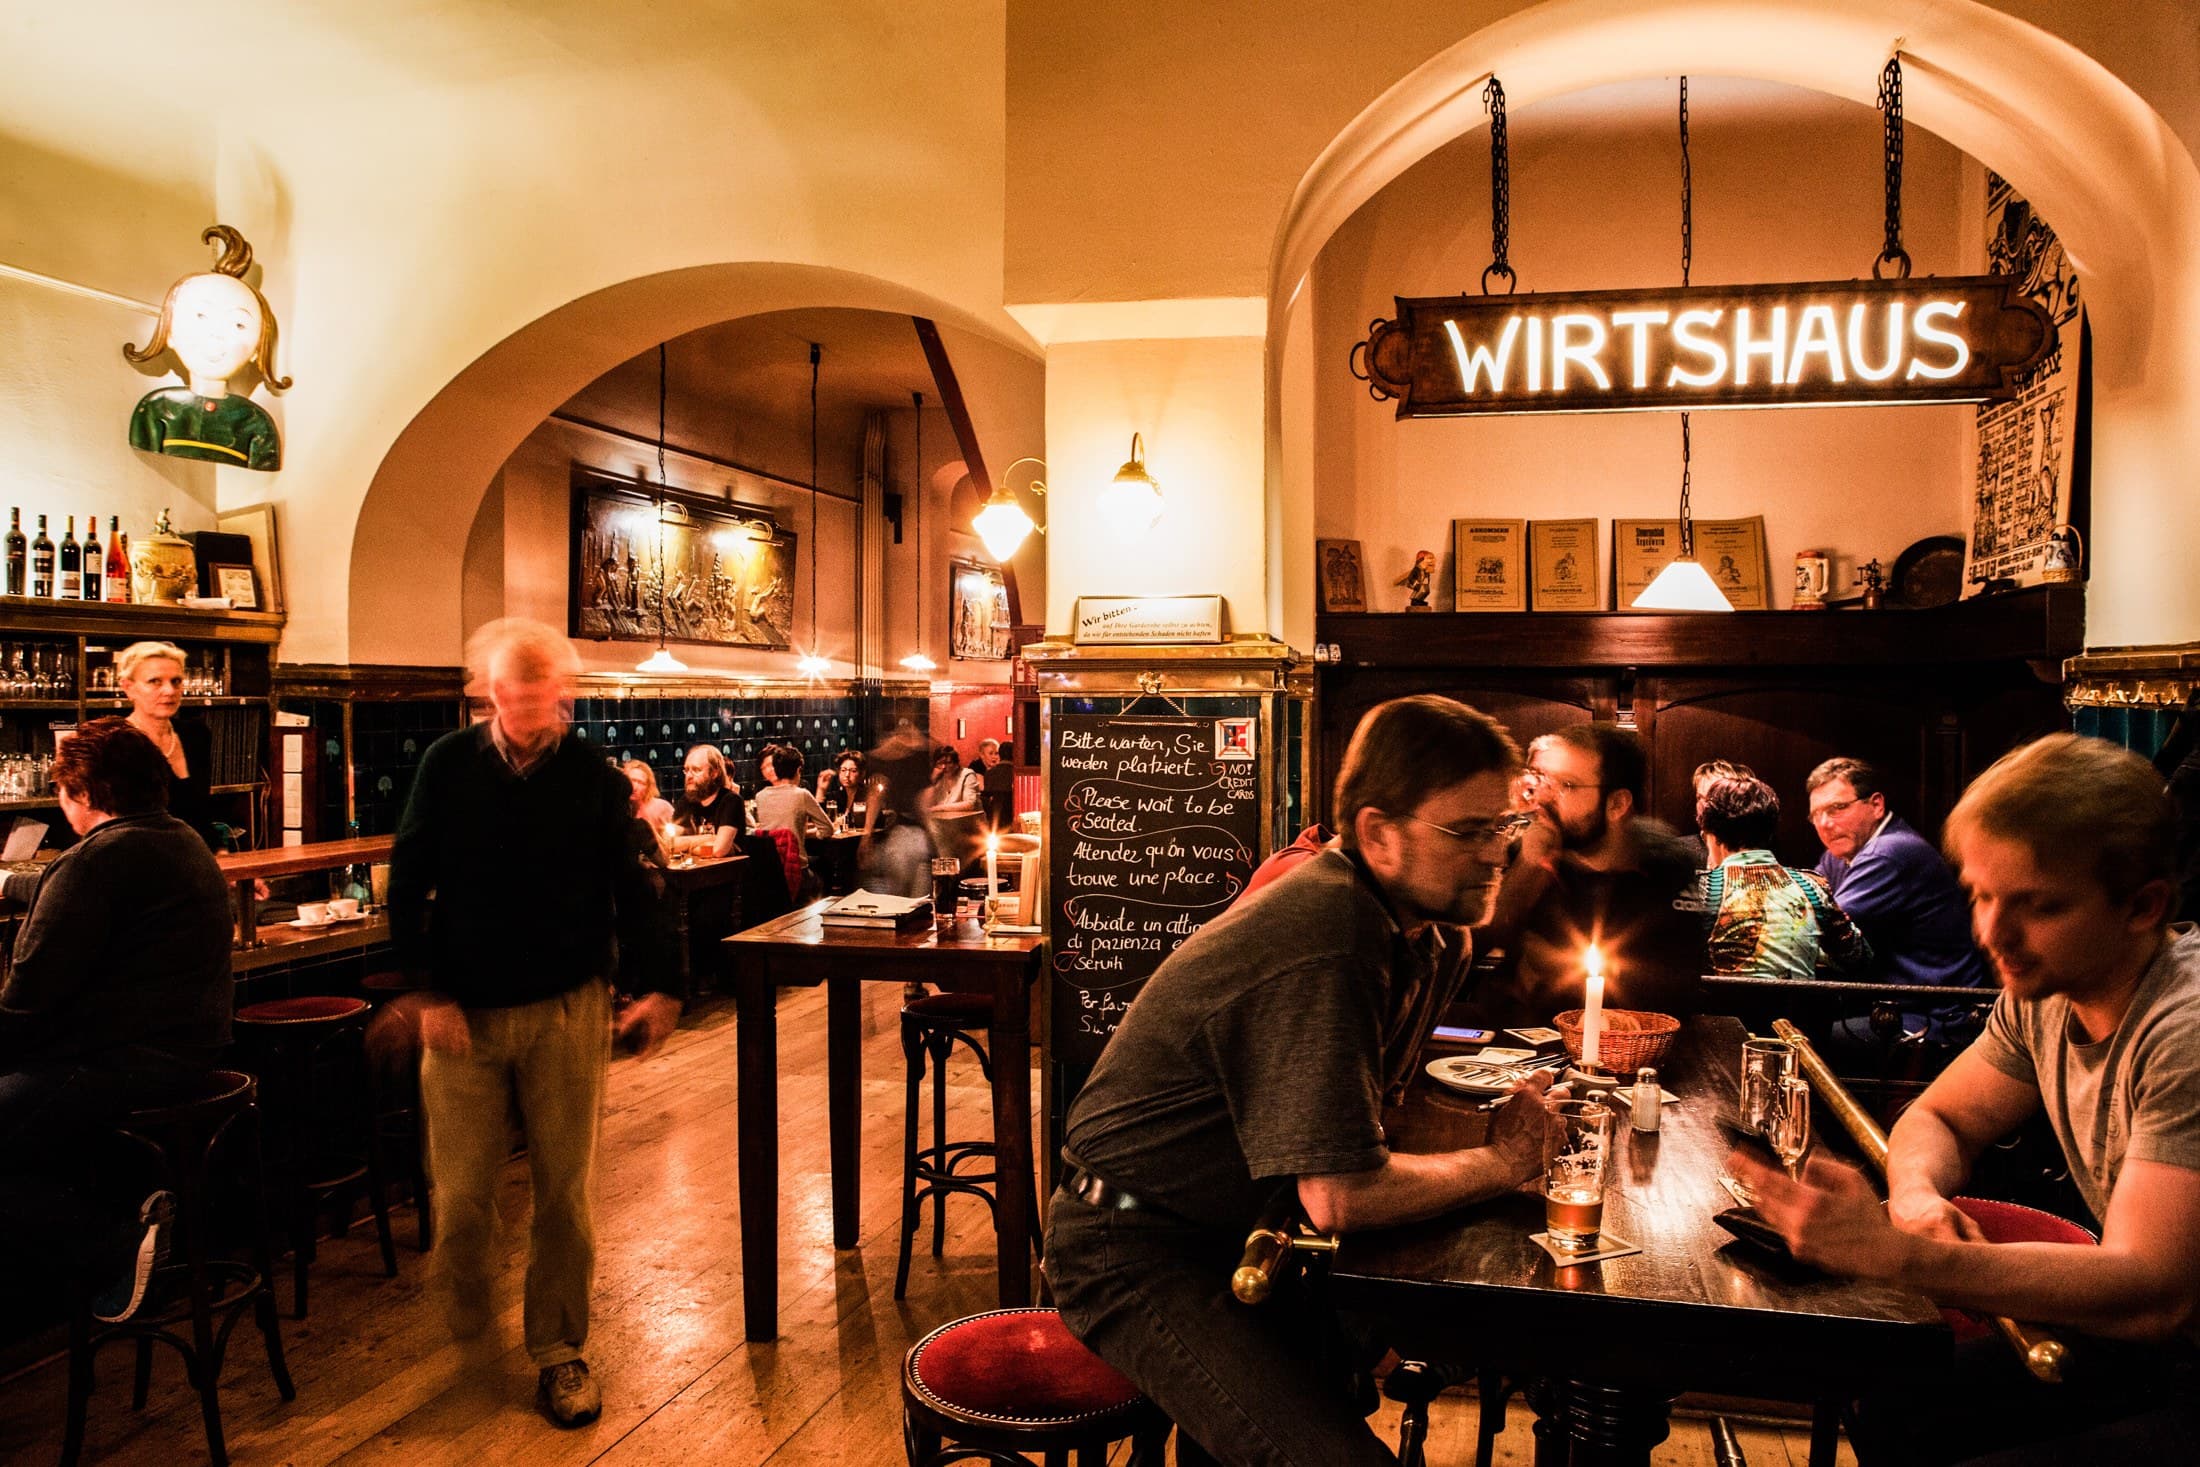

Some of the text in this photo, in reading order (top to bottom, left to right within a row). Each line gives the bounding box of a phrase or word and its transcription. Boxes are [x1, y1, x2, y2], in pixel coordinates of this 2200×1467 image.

[1443, 300, 1971, 393] WIRTSHAUS
[1082, 616, 1101, 627] Wir
[1102, 606, 1131, 621] bitten
[1060, 731, 1210, 757] Bitte warten, Sie
[1061, 753, 1108, 771] werden
[1228, 763, 1253, 776] NO!
[1218, 776, 1256, 790] CREDIT
[1081, 786, 1236, 816] Please wait to be
[1227, 789, 1255, 800] CARDS
[1081, 812, 1143, 833] Seated.
[1073, 840, 1143, 863] Attendez
[1192, 845, 1234, 862] vous
[1065, 861, 1220, 895] trouve une place.
[1075, 906, 1137, 931] Abbiate
[1143, 920, 1162, 932] un
[1067, 932, 1083, 949] di
[1091, 936, 1161, 959] pazienza
[1079, 989, 1099, 1009] Por
[1078, 1014, 1104, 1035] Su
